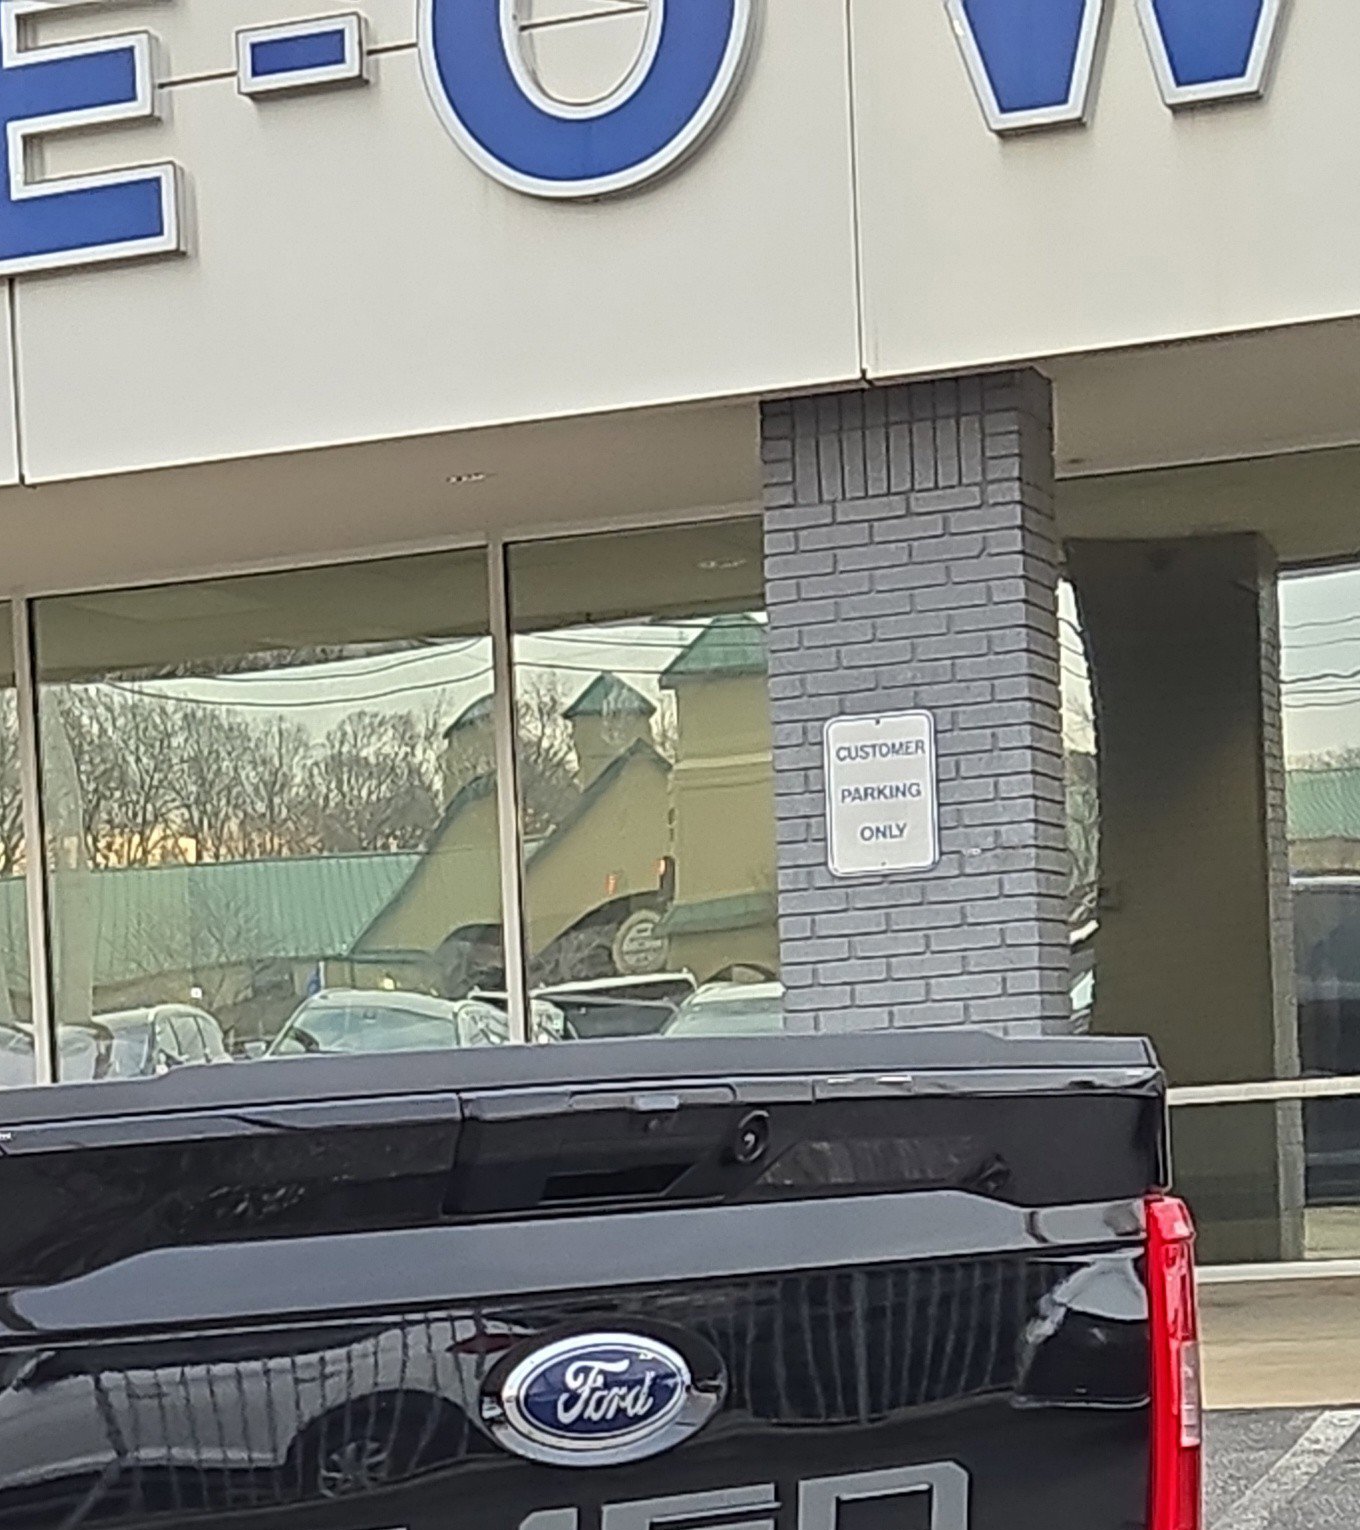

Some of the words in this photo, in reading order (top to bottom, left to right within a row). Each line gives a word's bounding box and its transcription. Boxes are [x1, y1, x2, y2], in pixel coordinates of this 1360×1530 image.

[836, 739, 926, 762] CUSTOMER
[841, 782, 922, 804] PARKING
[860, 822, 907, 842] ONLY
[557, 1359, 653, 1424] Ford
